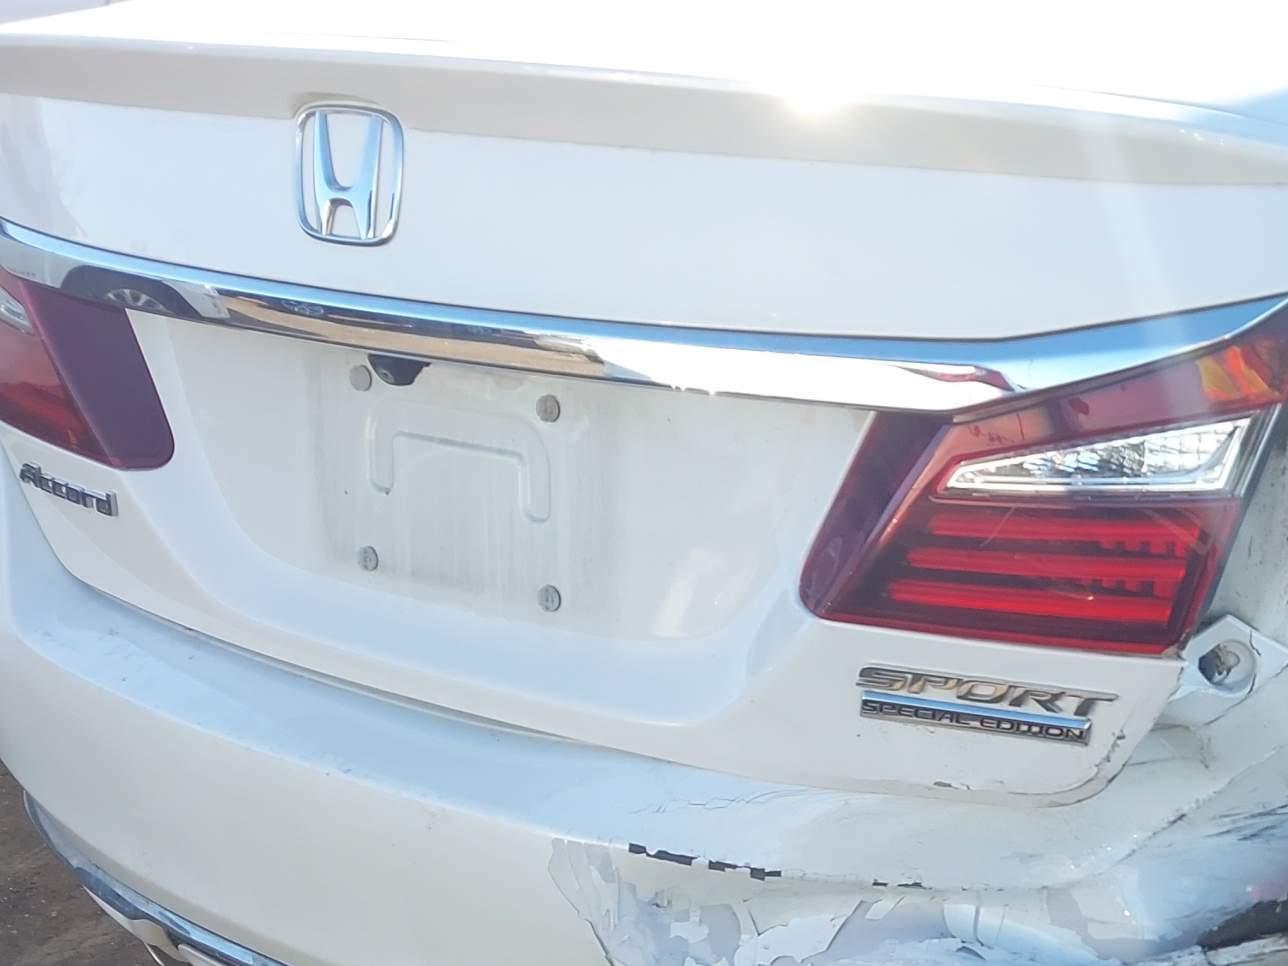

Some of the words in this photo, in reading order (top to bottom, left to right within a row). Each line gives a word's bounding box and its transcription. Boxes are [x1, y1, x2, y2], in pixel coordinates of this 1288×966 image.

[20, 461, 119, 516] Accord
[856, 664, 1120, 716] SPORT
[861, 698, 971, 727] SPECIAL
[980, 716, 1087, 743] EDITION
